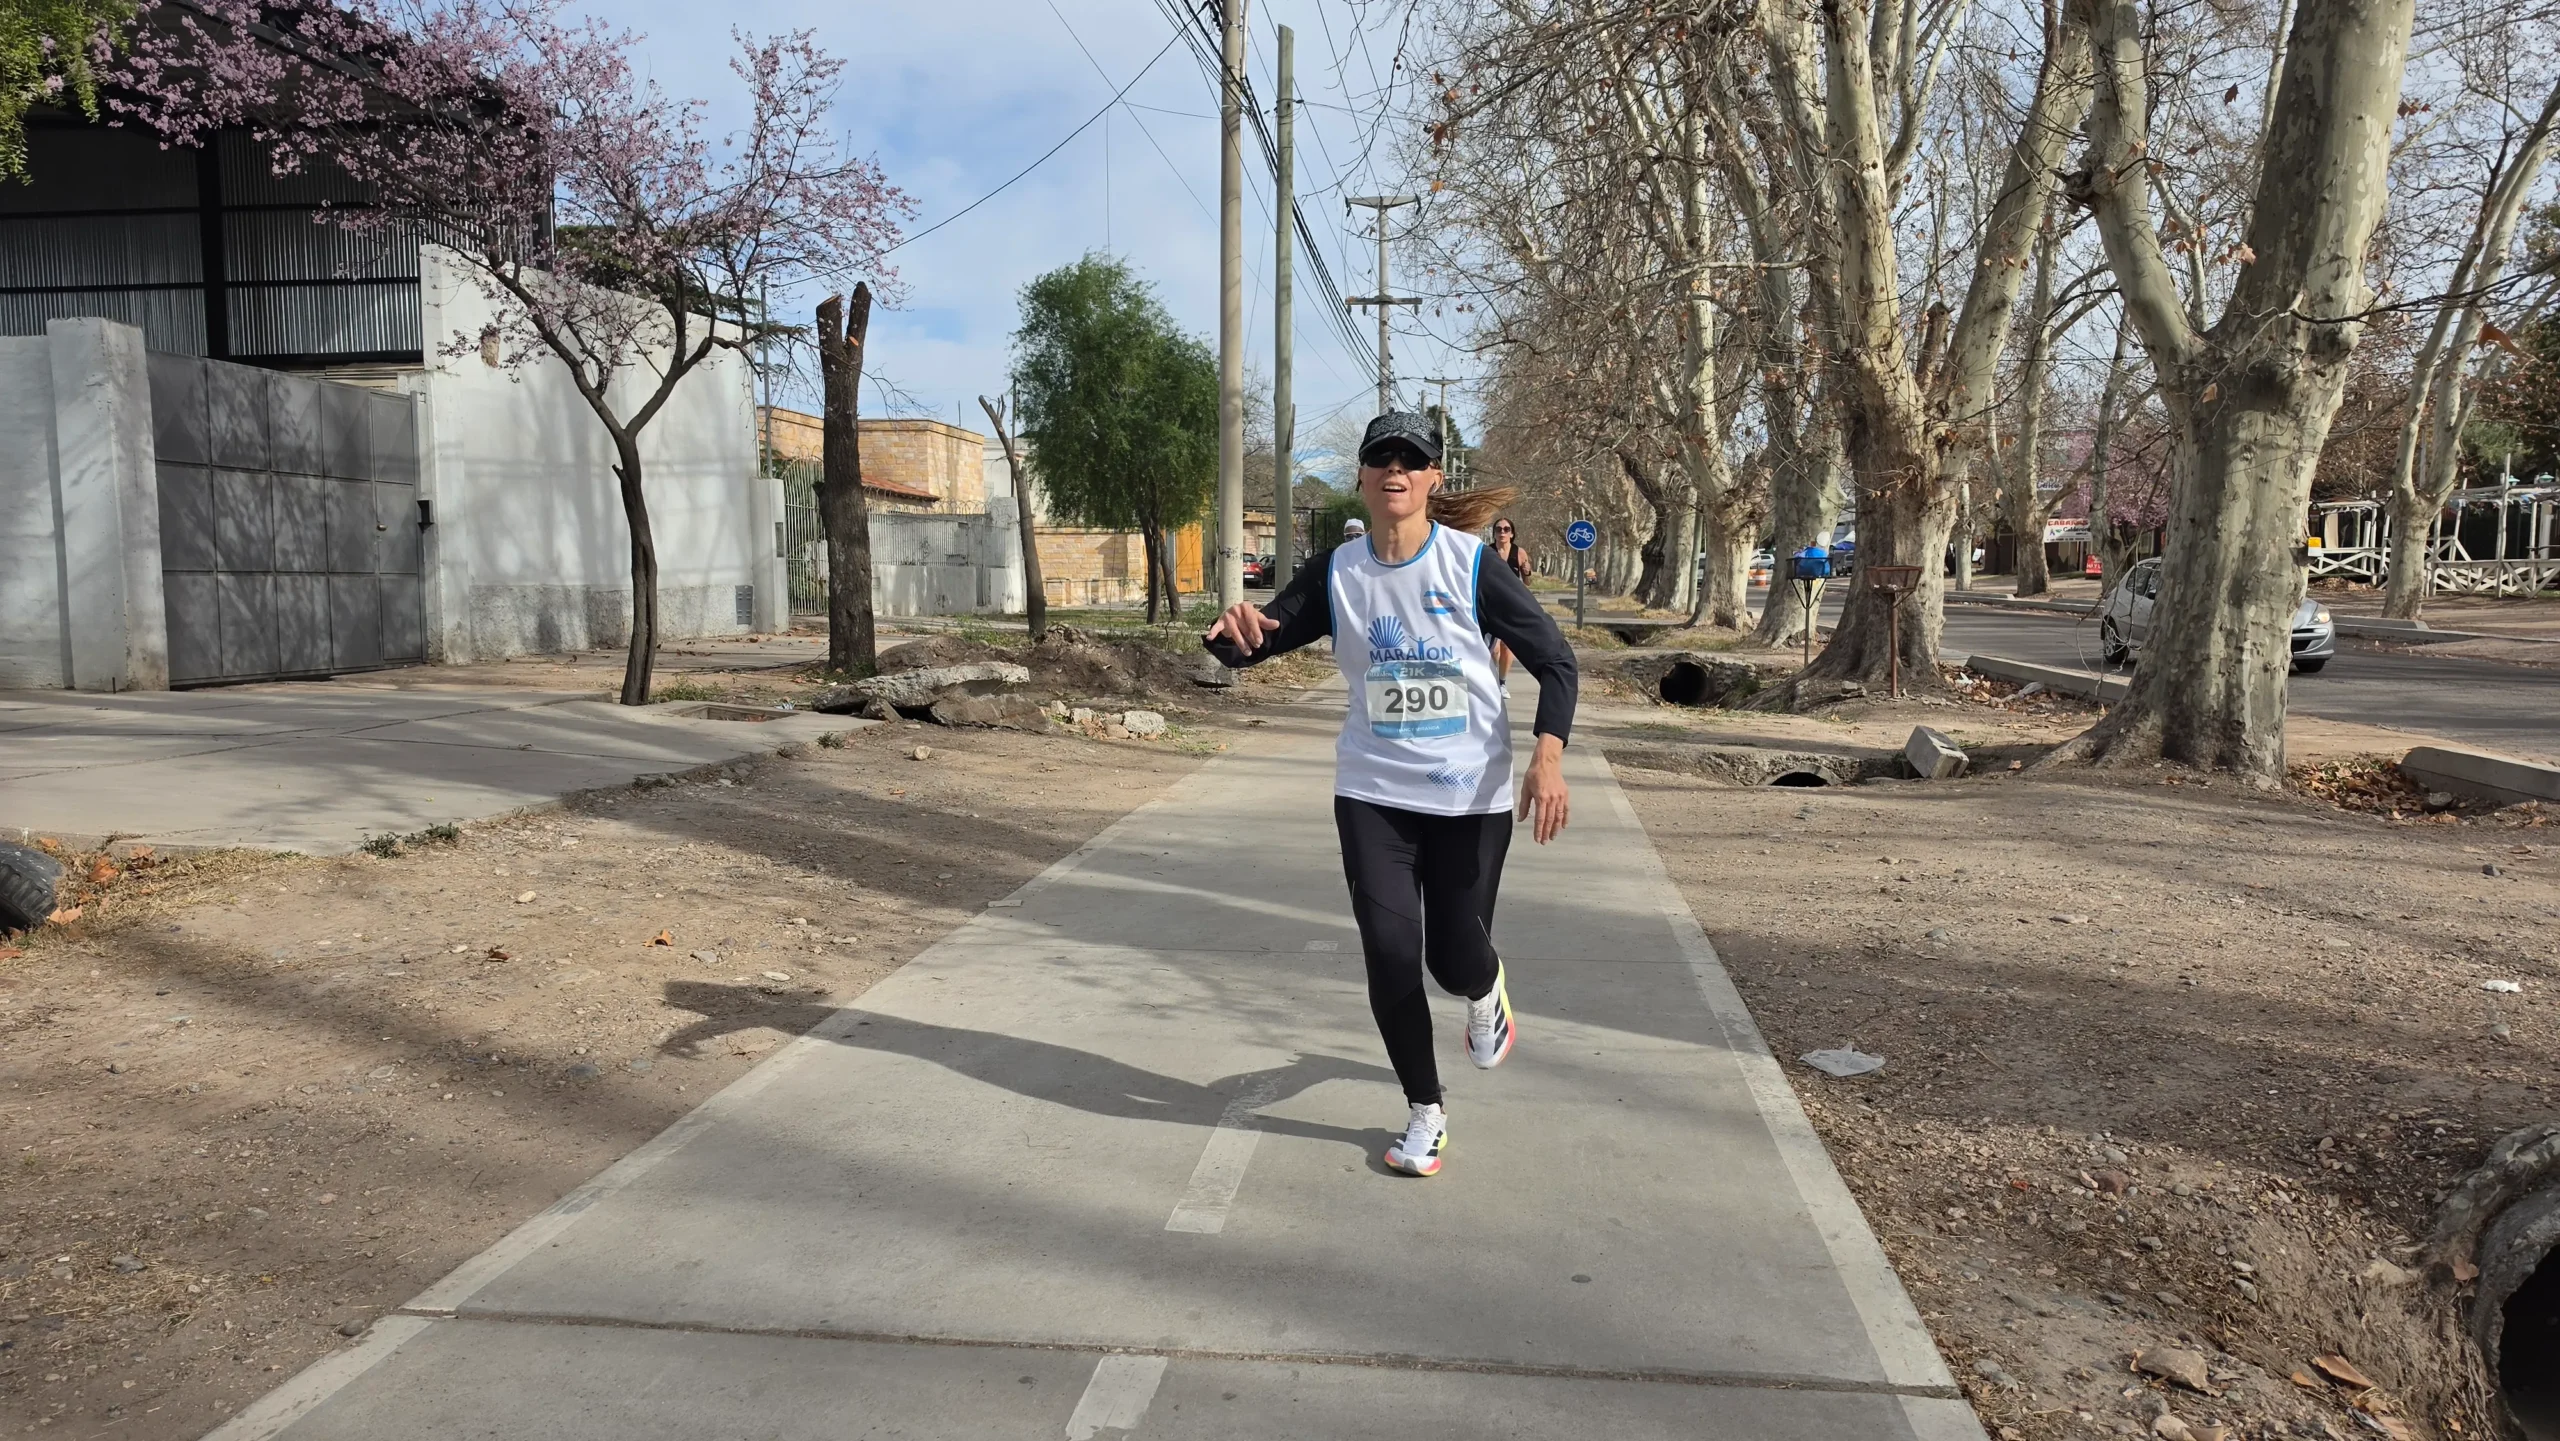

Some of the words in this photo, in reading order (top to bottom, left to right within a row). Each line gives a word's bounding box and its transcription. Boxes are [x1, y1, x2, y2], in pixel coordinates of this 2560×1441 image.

[1369, 643, 1453, 663] MARATON
[1400, 667, 1425, 677] 21K
[1384, 686, 1448, 713] 290
